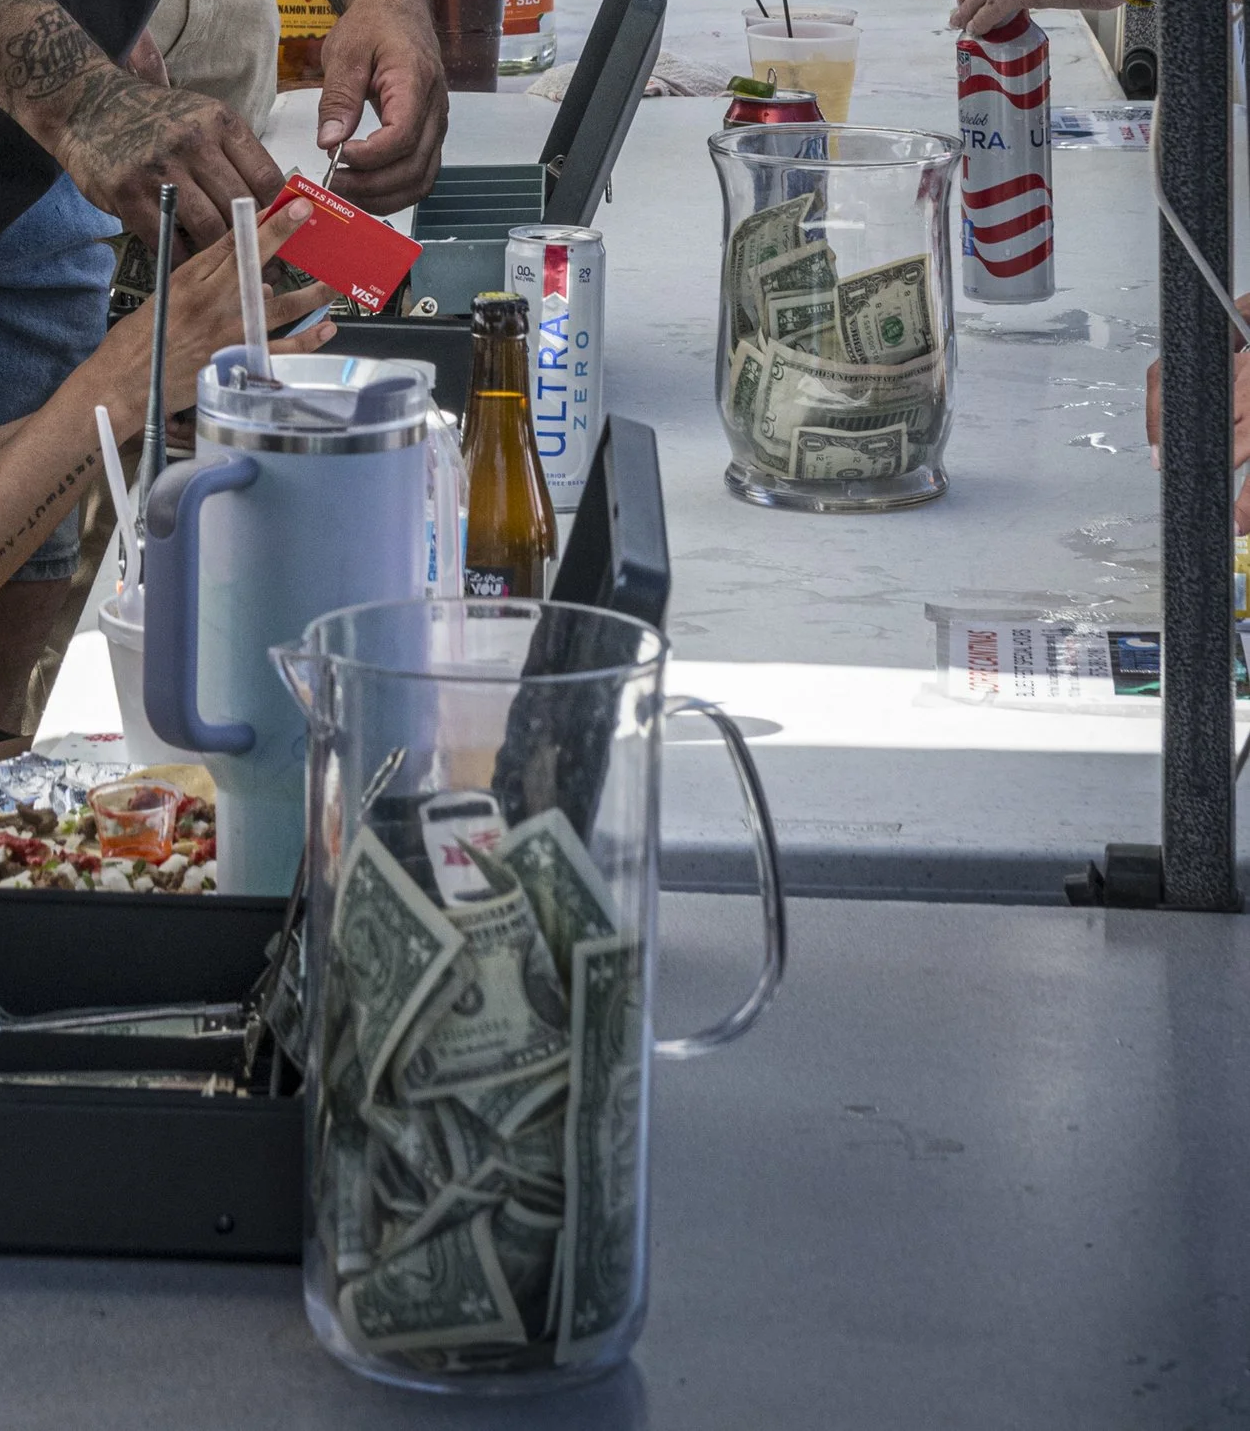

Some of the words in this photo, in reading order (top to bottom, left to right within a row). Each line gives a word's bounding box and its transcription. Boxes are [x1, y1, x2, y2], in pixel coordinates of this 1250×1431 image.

[309, 4, 337, 15] WHIS
[296, 180, 326, 202] WELLS
[326, 196, 355, 218] FARGO
[578, 267, 592, 279] 29
[351, 282, 380, 308] VISA
[369, 284, 386, 296] DEBIT
[536, 311, 570, 457] ULTRA
[573, 330, 589, 430] ZERO
[470, 583, 502, 596] YOU
